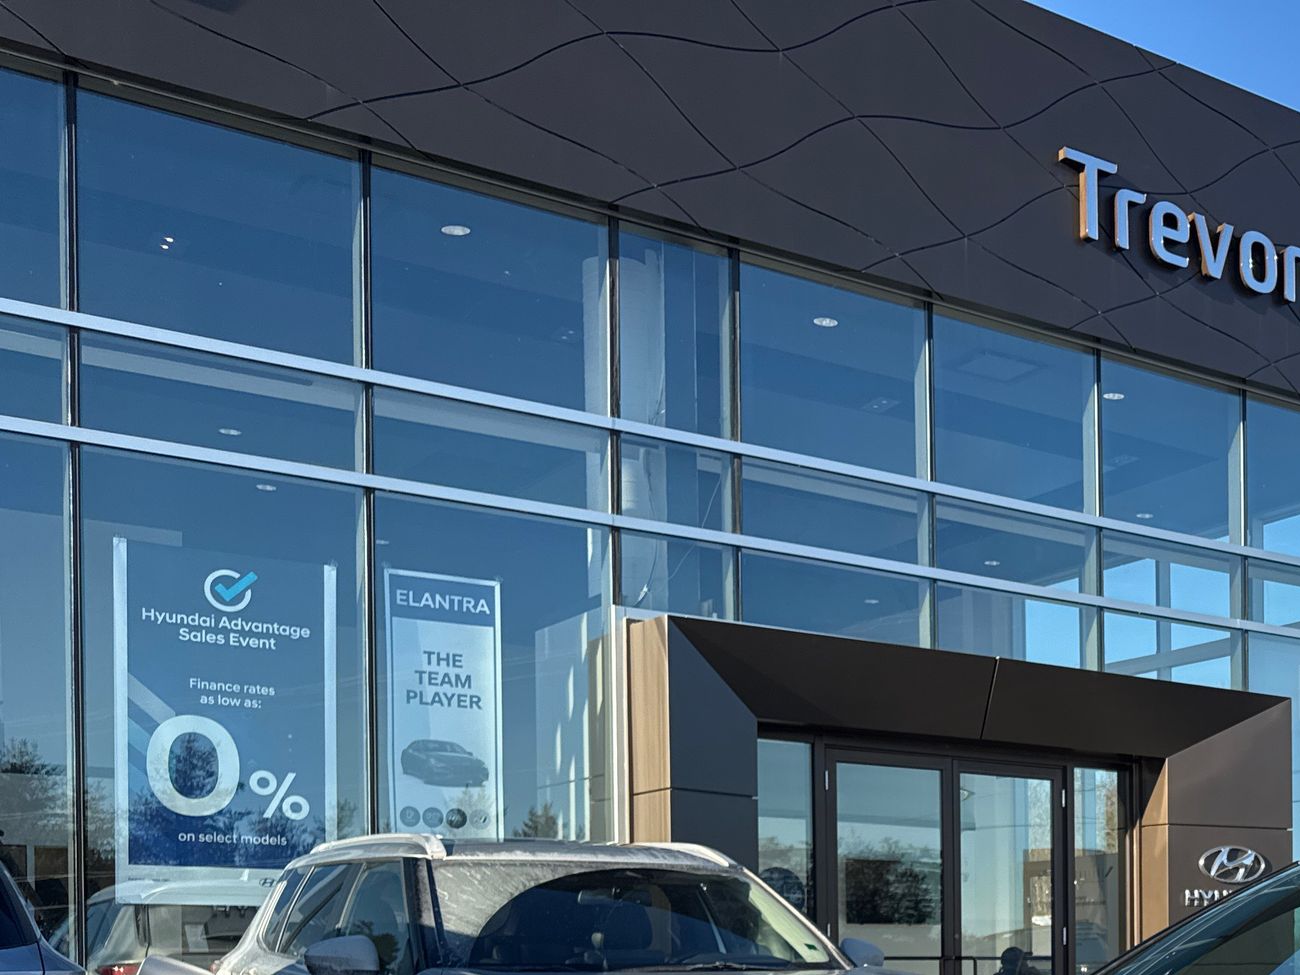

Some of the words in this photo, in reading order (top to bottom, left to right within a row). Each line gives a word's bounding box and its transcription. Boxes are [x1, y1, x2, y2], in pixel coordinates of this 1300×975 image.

[396, 589, 490, 615] ELANTRA
[142, 607, 215, 628] Hyundai
[218, 616, 311, 640] Advantage
[179, 628, 225, 645] Sales
[229, 633, 276, 650] Event
[423, 650, 463, 669] THE
[189, 677, 241, 693] Finance
[244, 683, 276, 696] rates
[414, 670, 471, 689] TEAM
[200, 696, 214, 705] as
[217, 694, 241, 707] low
[244, 698, 262, 709] as:
[406, 689, 482, 710] PLAYER
[178, 833, 196, 843] on
[199, 832, 237, 844] select
[240, 834, 287, 846] models
